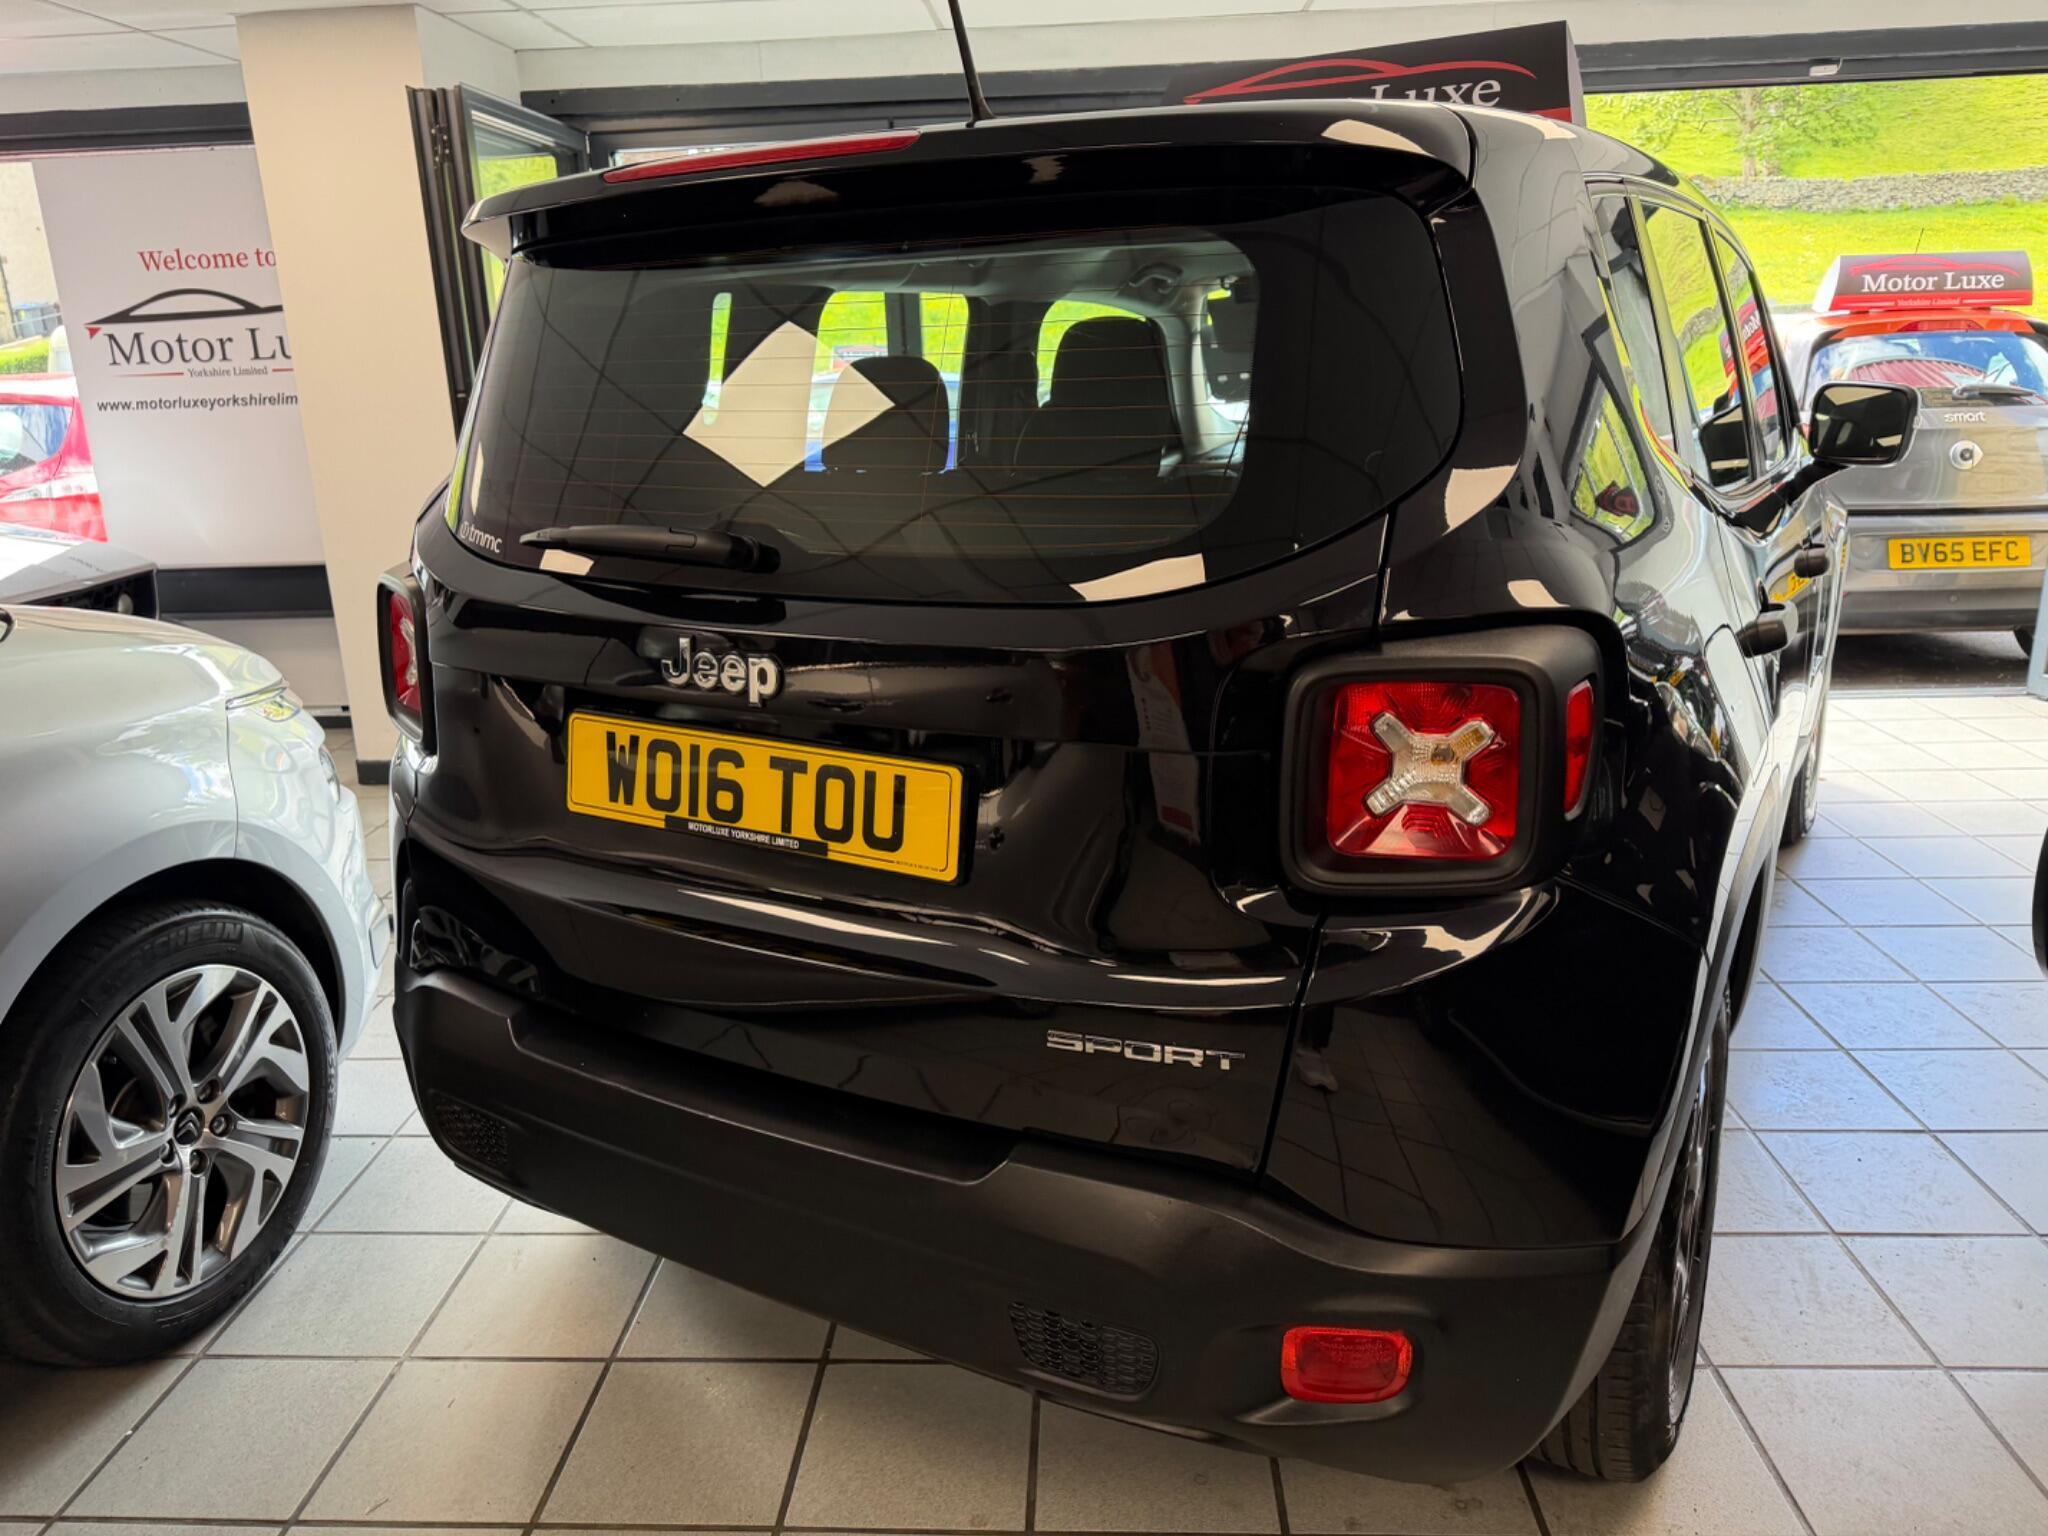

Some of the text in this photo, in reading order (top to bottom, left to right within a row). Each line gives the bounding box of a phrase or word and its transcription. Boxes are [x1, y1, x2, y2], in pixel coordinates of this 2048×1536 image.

[137, 248, 276, 272] Welcome to
[1861, 271, 2005, 293] Motor Luxe
[103, 331, 233, 366] Motor
[187, 365, 268, 379] Yorkshire Limited
[97, 392, 298, 412] www.motorluxeyorkshirelim
[1944, 411, 1986, 423] smart
[1901, 540, 2019, 565] BV65 EFC
[661, 634, 783, 708] Jeep
[605, 730, 907, 853] WO16 TOU
[688, 821, 800, 849] MOTORLUXE YORKSHIRE LIMITED
[1046, 1029, 1246, 1070] SPORT
